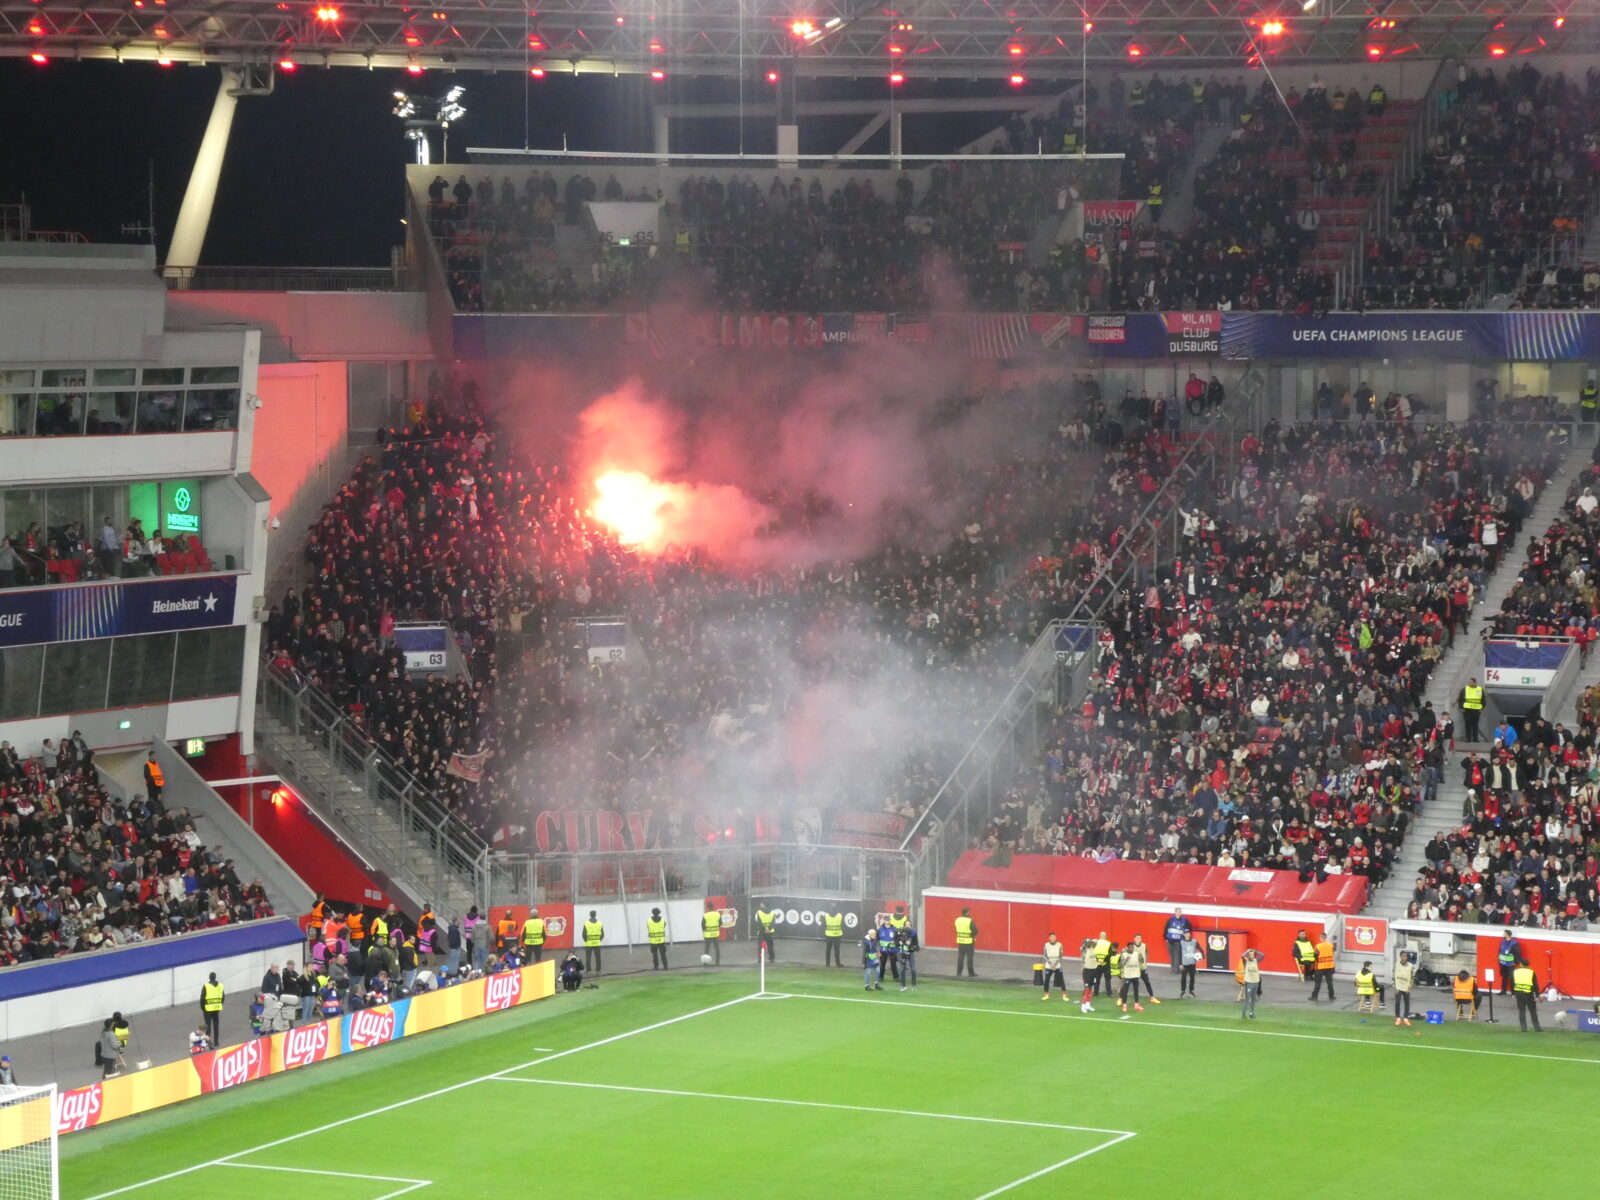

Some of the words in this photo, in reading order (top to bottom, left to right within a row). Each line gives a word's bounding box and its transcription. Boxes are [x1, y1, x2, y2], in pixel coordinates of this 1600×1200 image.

[1182, 313, 1213, 324] MILAN
[1183, 327, 1210, 338] CLUB
[1292, 330, 1327, 341] UEFA
[1330, 330, 1408, 341] CHAMPIONS
[1412, 330, 1464, 341] LEAGUE
[152, 600, 200, 614] Heineken
[0, 613, 23, 627] GUE
[429, 654, 443, 665] G3
[1486, 670, 1500, 682] F4
[486, 970, 520, 1009] Lay's
[352, 1010, 393, 1047] Lay's
[286, 1024, 327, 1065] Lay's
[217, 1040, 258, 1089] Lay's
